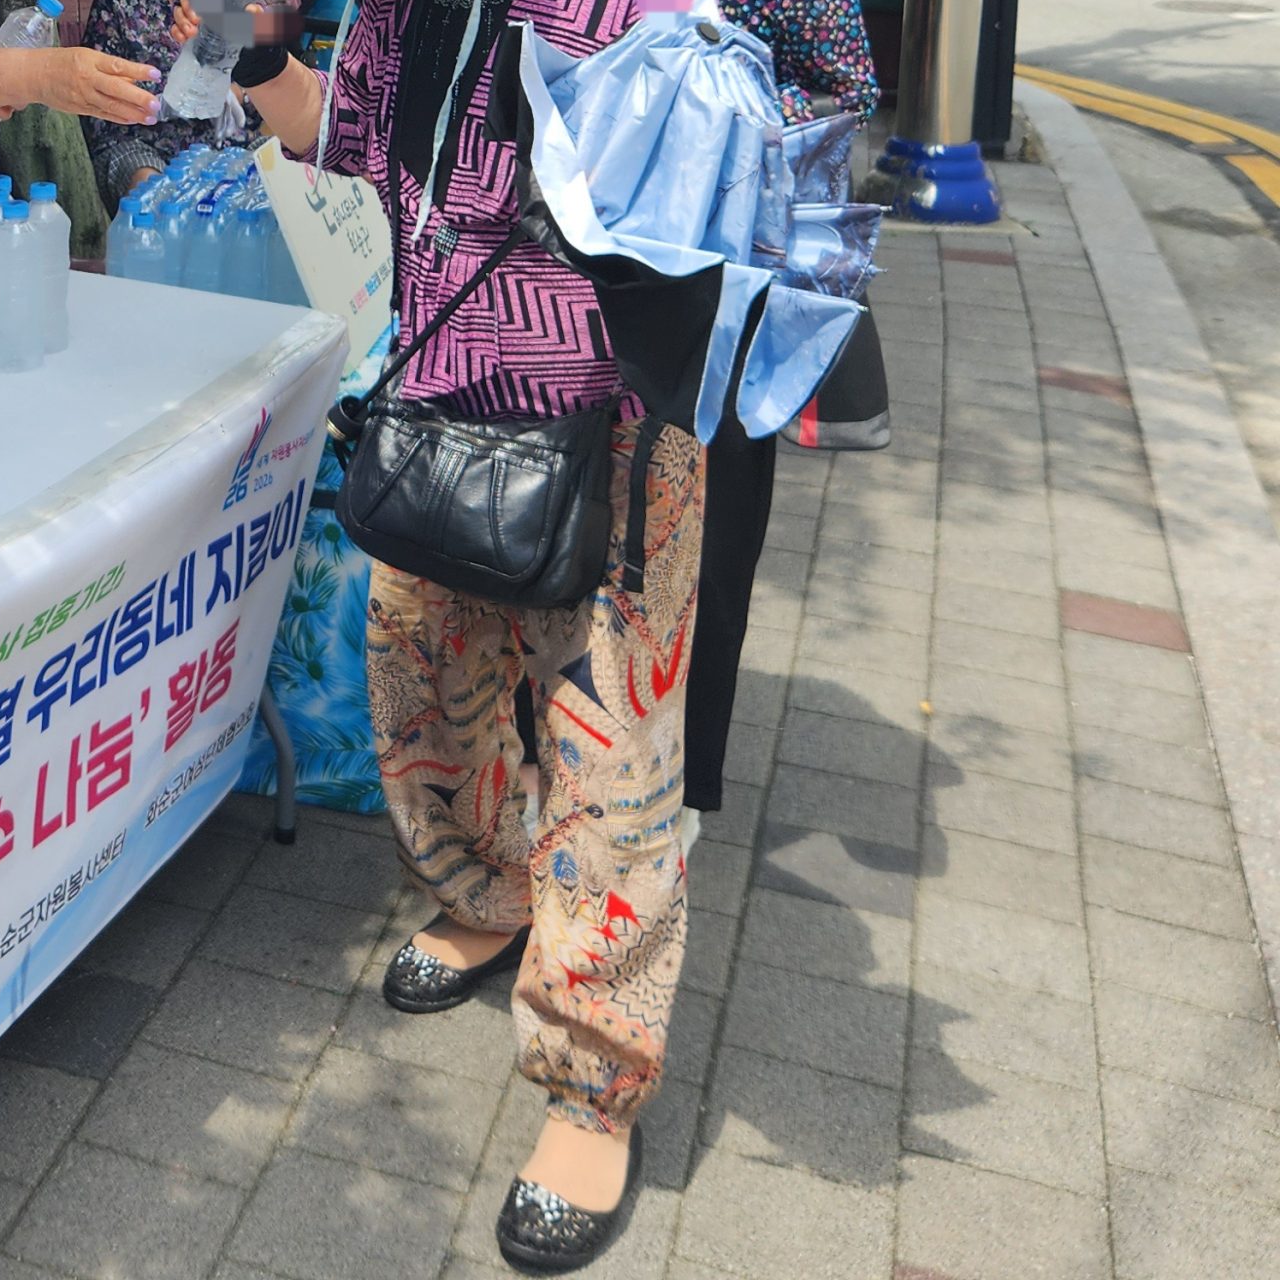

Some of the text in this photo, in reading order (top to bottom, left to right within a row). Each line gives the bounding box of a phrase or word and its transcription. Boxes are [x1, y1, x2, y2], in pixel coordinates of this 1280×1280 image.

[253, 473, 274, 493] 2026
[26, 550, 197, 734] 우리동네
[204, 478, 306, 617] 지킴이
[163, 616, 240, 753] 활동
